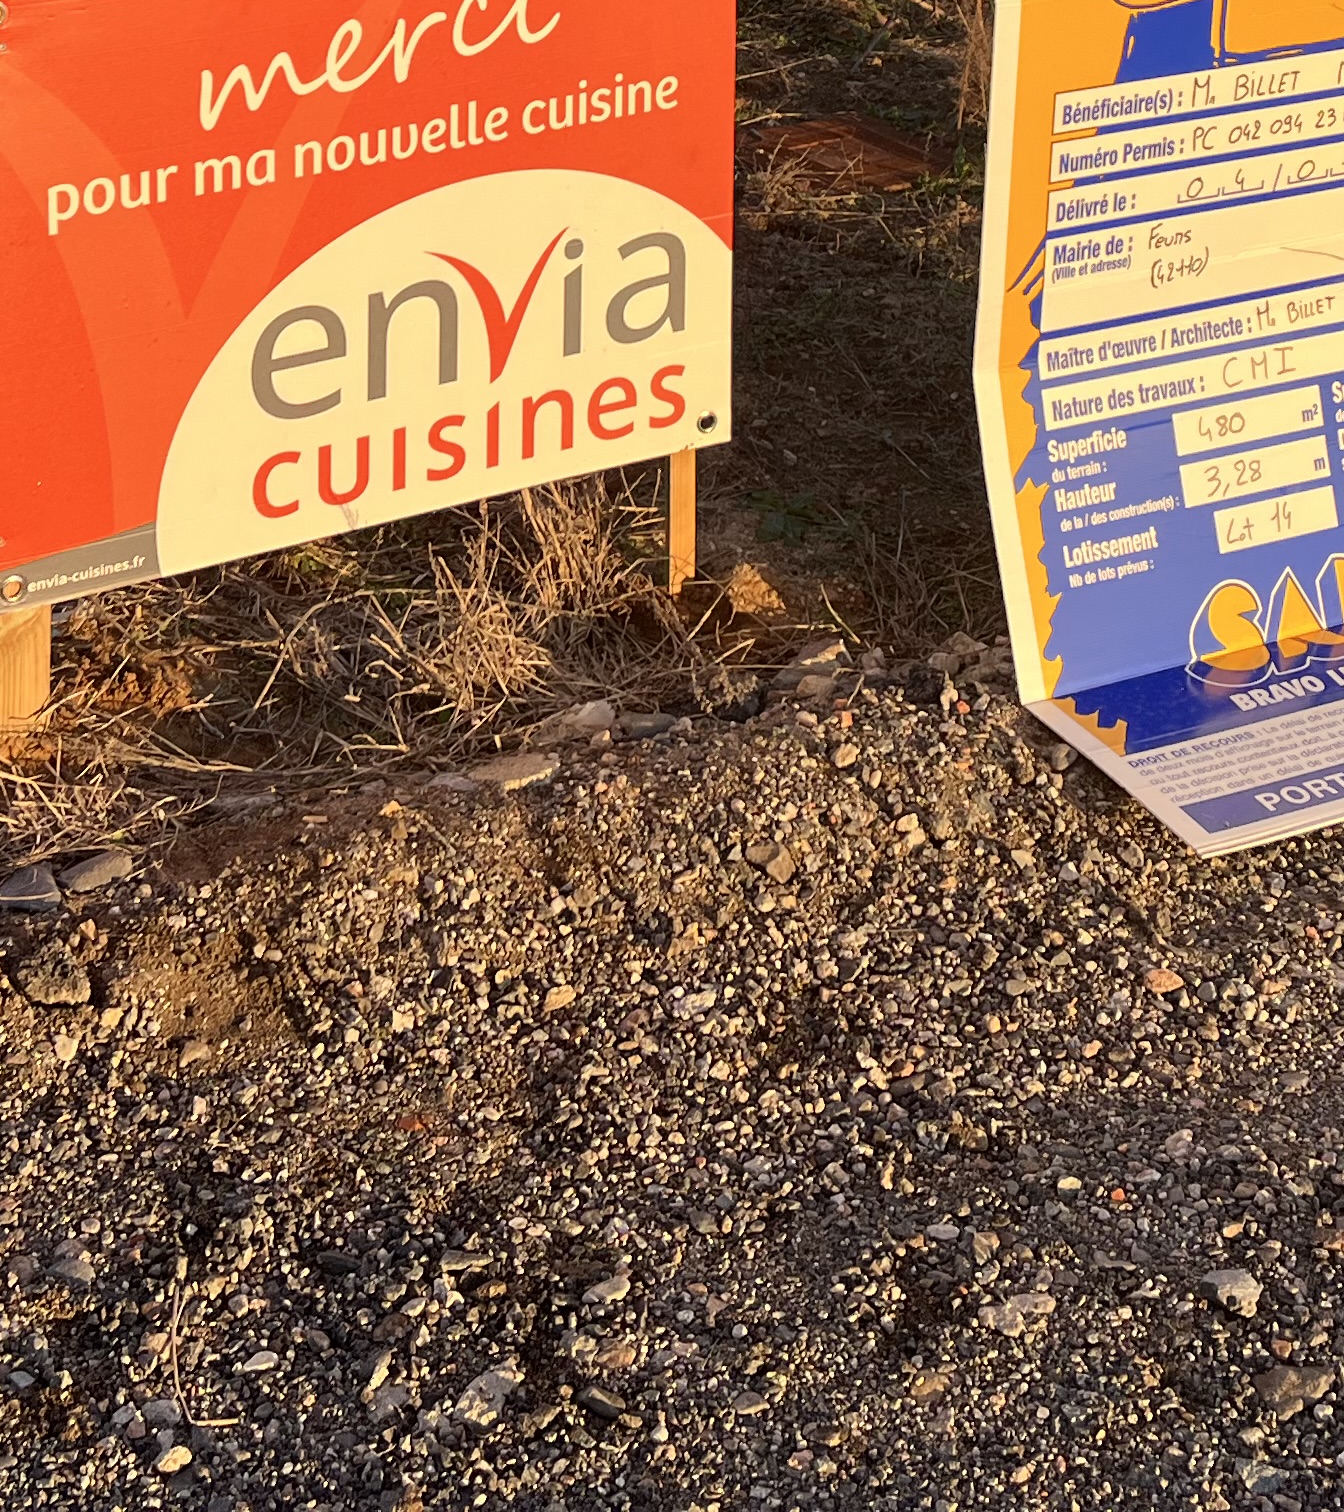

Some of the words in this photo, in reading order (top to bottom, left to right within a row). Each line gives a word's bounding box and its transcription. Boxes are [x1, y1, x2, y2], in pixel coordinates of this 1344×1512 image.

[1192, 126, 1218, 152] PC
[1228, 119, 1261, 144] 042
[1270, 113, 1303, 134] 094
[47, 164, 177, 235] pour
[194, 146, 276, 197] ma
[294, 104, 507, 178] nouvelle
[522, 76, 679, 131] cuisine
[1058, 146, 1118, 174] Numéro
[1056, 199, 1108, 223] Délivré
[1053, 239, 1100, 266] Mairie
[1052, 264, 1076, 284] (Ville
[1079, 262, 1088, 276] et
[1090, 254, 1131, 274] adresse)
[250, 226, 687, 420] envia
[1047, 347, 1094, 372] Maître
[1051, 396, 1103, 422] Nature
[1107, 389, 1134, 410] des
[1047, 427, 1127, 463] Superficie
[1052, 467, 1065, 483] du
[1054, 482, 1117, 512] Hauteur
[1060, 517, 1073, 533] de
[1074, 514, 1083, 529] la
[1090, 509, 1107, 526] des
[1062, 526, 1159, 569] Lotissement
[27, 555, 145, 592] envia-cuisines.fr
[1069, 572, 1083, 589] Nb
[1084, 570, 1097, 584] de
[1098, 565, 1116, 581] lots
[1229, 672, 1326, 712] BRAVO
[1127, 752, 1171, 769] DROIT
[1168, 746, 1193, 758] DE
[1189, 730, 1257, 753] RECOURS
